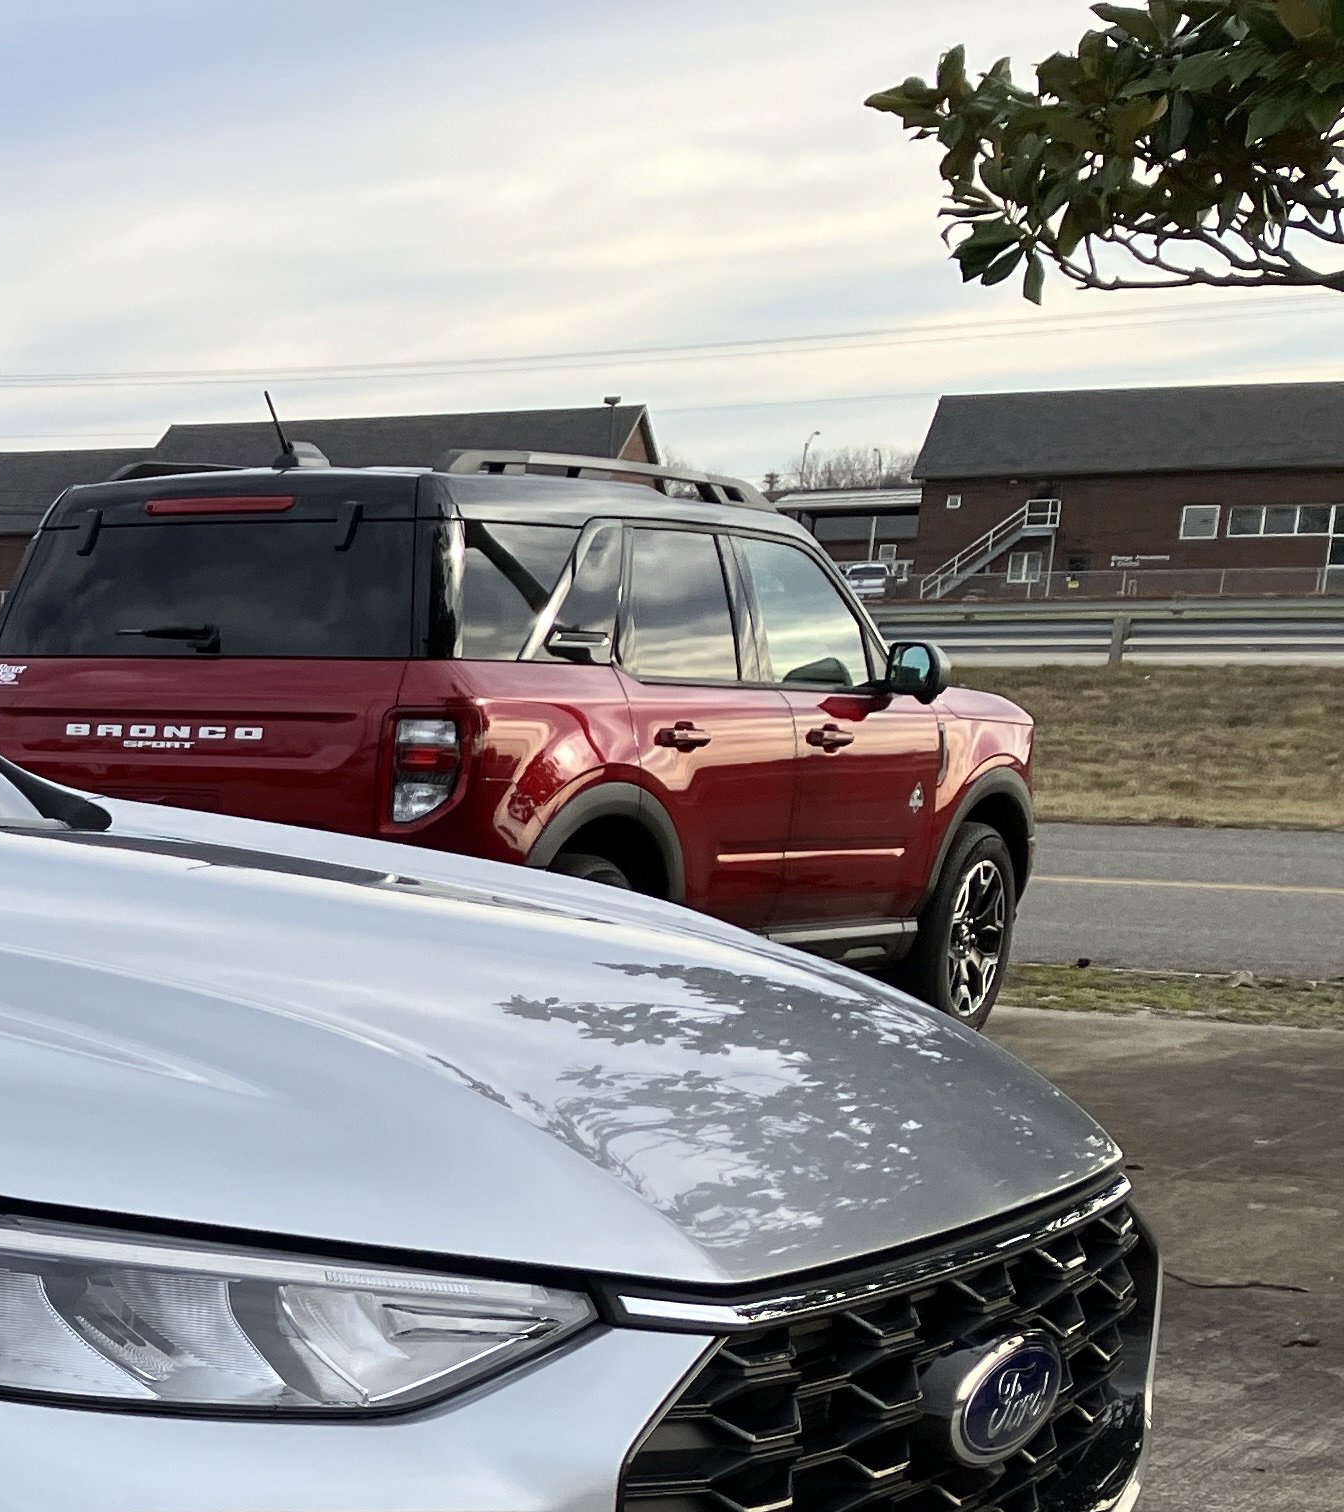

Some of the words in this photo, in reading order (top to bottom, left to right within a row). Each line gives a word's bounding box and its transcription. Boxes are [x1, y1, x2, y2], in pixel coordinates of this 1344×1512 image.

[65, 723, 264, 740] BRONCO
[123, 740, 196, 749] SPORT
[987, 1361, 1051, 1440] Ford
